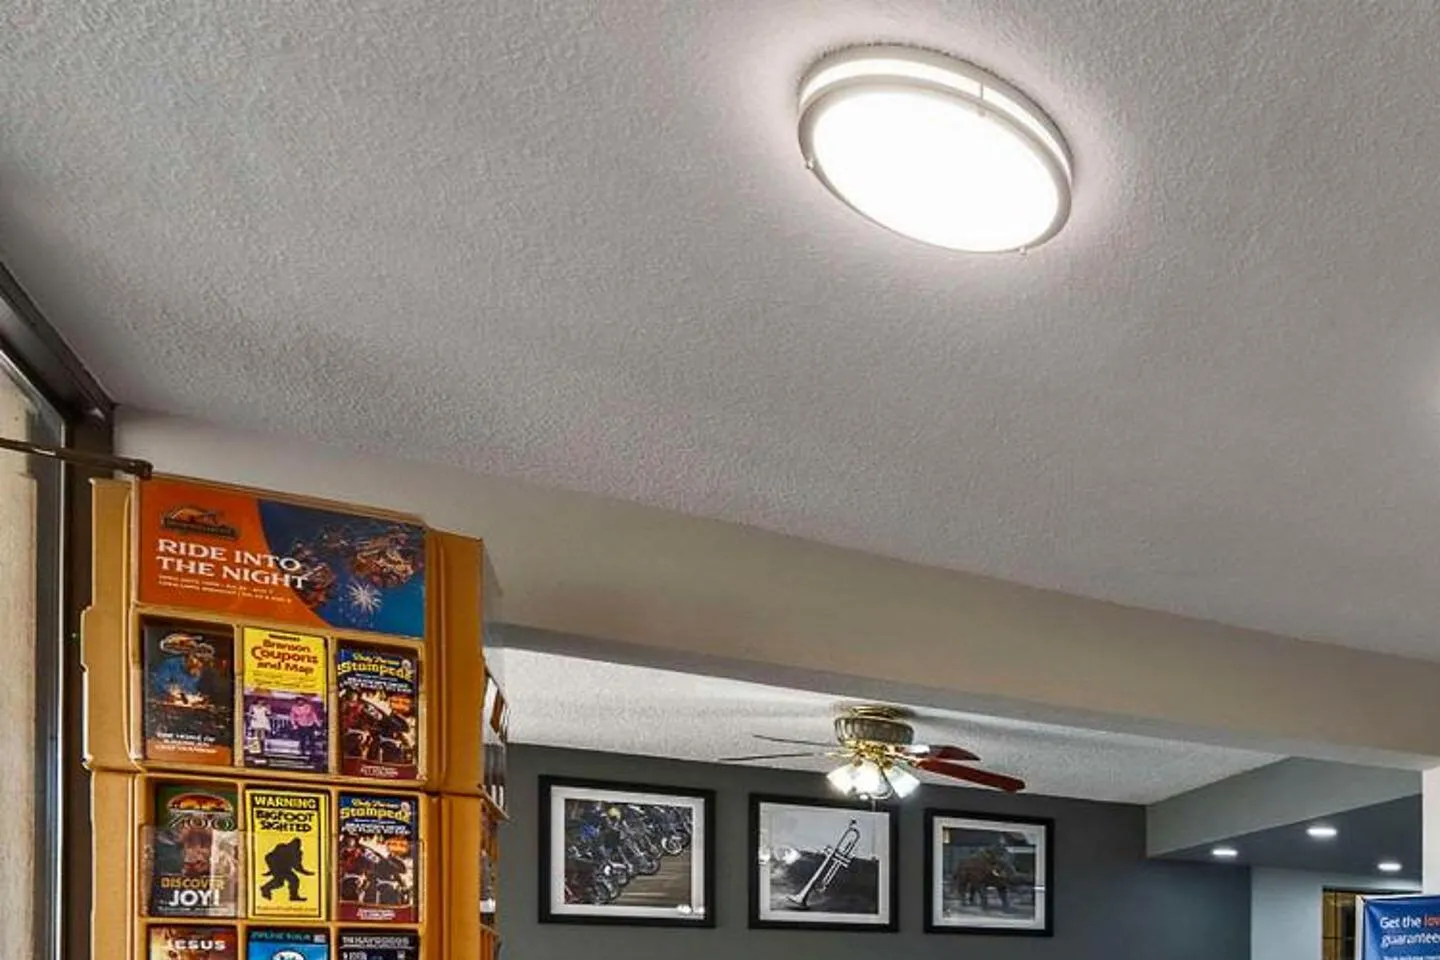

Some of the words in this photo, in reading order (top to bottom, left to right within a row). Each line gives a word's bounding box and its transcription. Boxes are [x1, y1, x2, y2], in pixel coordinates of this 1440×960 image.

[157, 538, 228, 562] RIDE
[234, 550, 301, 571] INTO
[156, 556, 215, 577] THE
[222, 565, 308, 589] NIGHT
[251, 646, 318, 664] Coupons
[257, 661, 281, 670] and
[285, 662, 314, 676] Map
[254, 796, 316, 808] WARNING
[255, 810, 315, 822] BIGFOOT
[260, 820, 312, 832] SIGHTED
[168, 889, 220, 907] JOY!
[1380, 916, 1400, 929] Get
[1402, 915, 1421, 928] the
